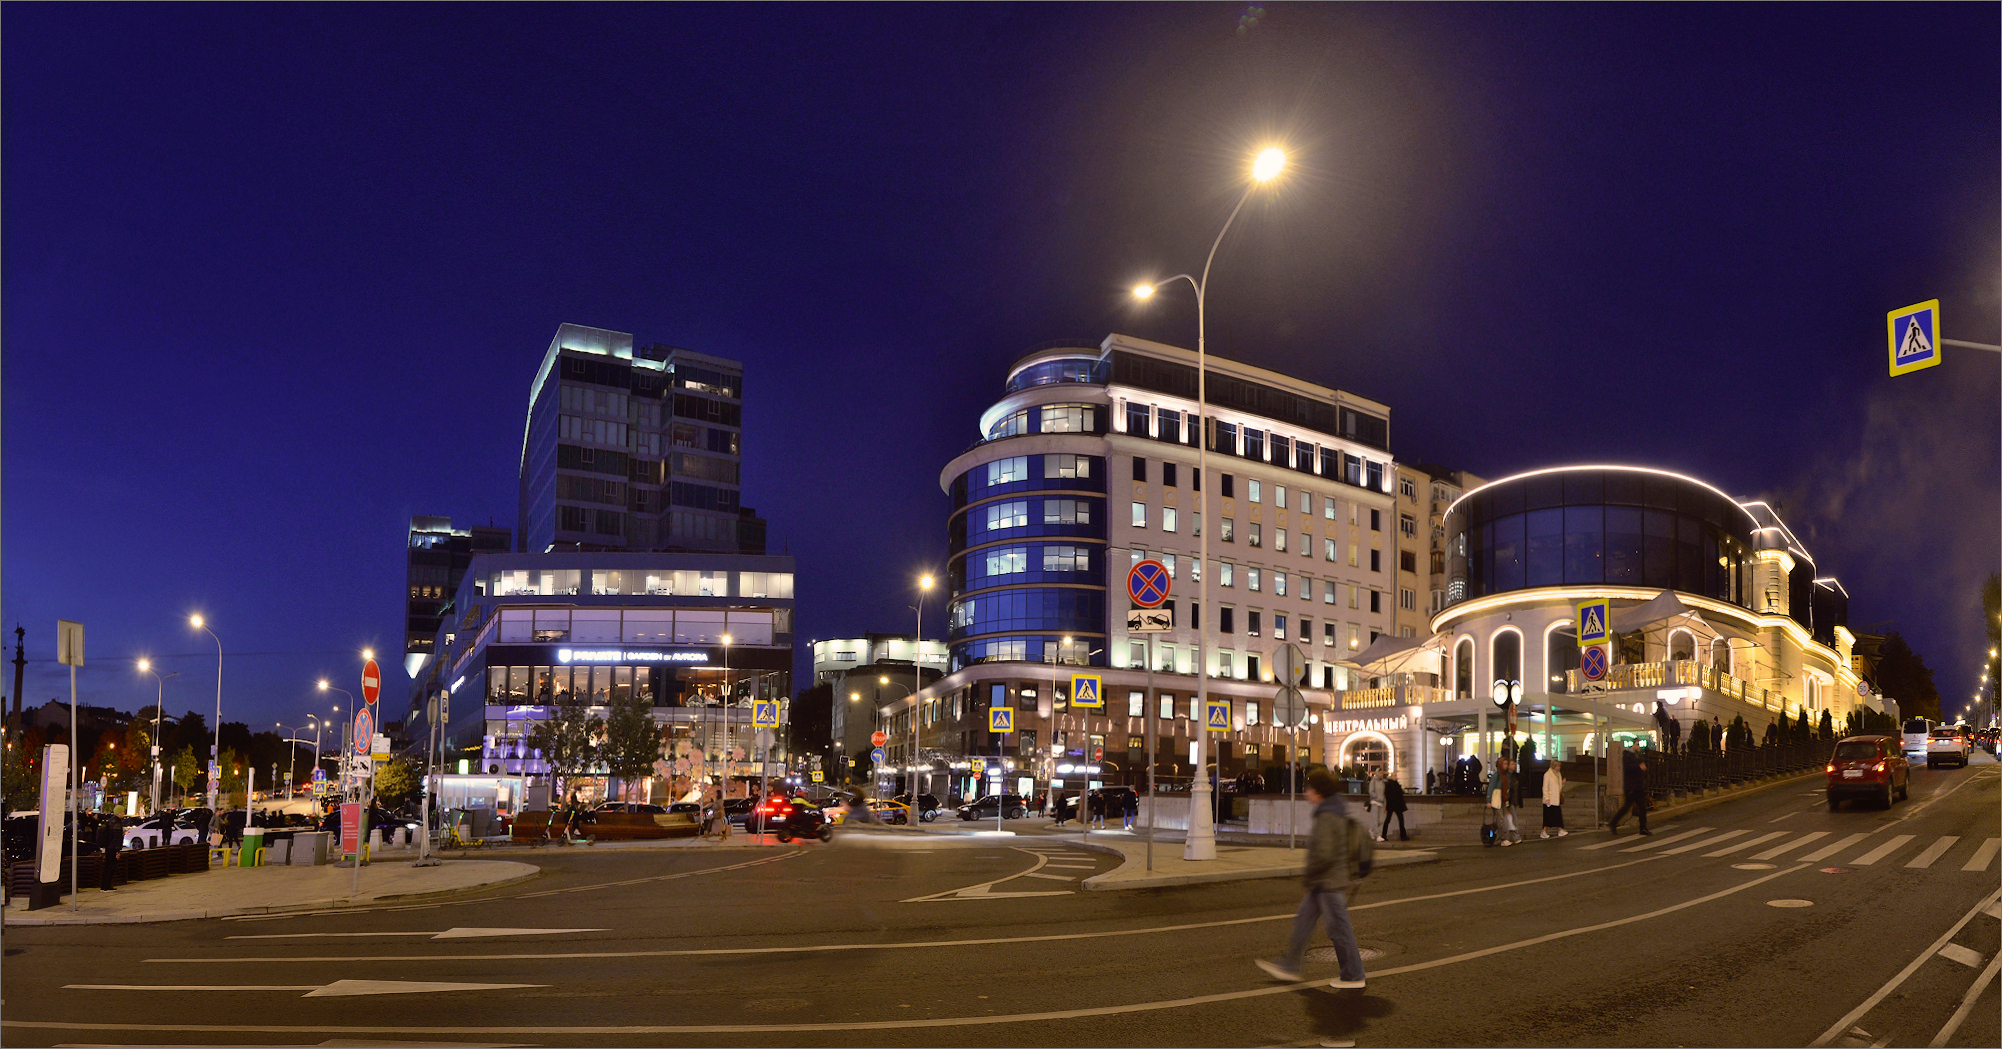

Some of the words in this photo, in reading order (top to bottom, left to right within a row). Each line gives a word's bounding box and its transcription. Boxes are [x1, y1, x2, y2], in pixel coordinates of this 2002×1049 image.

[573, 651, 622, 661] PRIVATE
[627, 652, 663, 661] GARDEN
[672, 652, 709, 661] AVRORA
[1325, 714, 1408, 734] ЦЕНТРАЛЬНЫЙ
